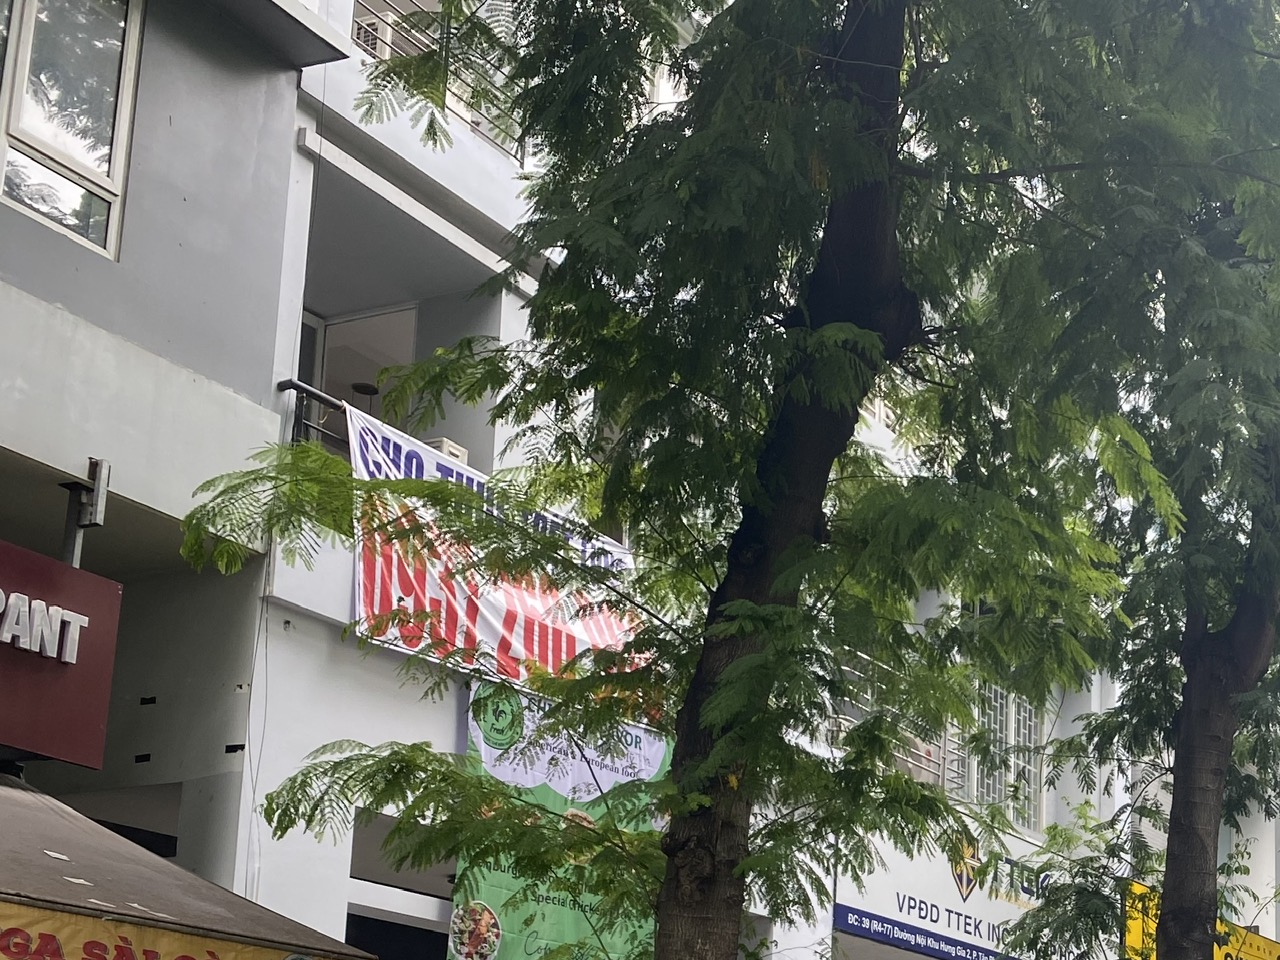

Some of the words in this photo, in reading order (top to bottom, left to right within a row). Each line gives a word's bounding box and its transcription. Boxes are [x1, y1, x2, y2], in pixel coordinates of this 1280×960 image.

[0, 588, 89, 664] ANT
[530, 738, 568, 757] merican
[622, 764, 638, 779] foo
[992, 854, 1051, 900] TEK
[569, 897, 598, 914] Chick
[897, 891, 940, 923] VPĐD
[945, 908, 983, 939] TTEK
[847, 913, 860, 926] ĐC:
[861, 917, 870, 929] 39
[870, 920, 893, 938] (R4-77)
[927, 937, 939, 949] Khu
